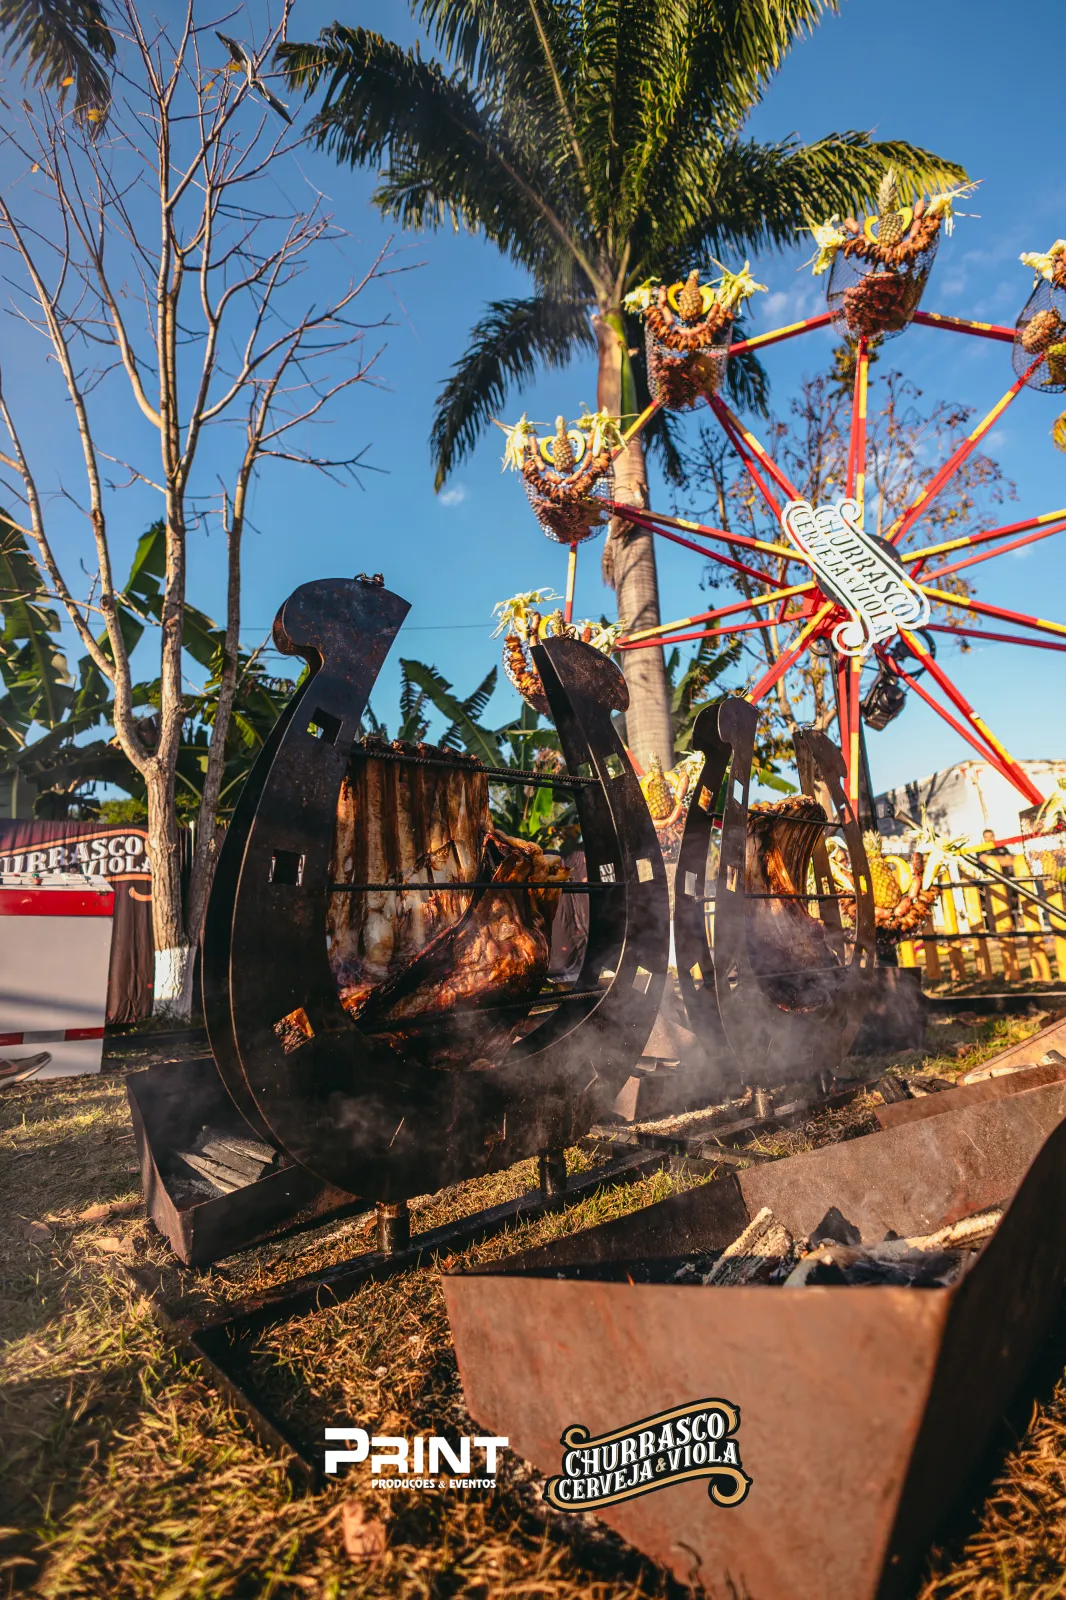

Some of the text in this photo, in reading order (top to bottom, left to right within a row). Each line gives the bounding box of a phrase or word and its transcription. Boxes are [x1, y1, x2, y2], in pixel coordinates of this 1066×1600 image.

[793, 511, 850, 578] CERVEJA
[850, 582, 892, 636] VIOLA
[814, 509, 914, 617] CHURRASCO
[0, 836, 144, 874] URRASCO
